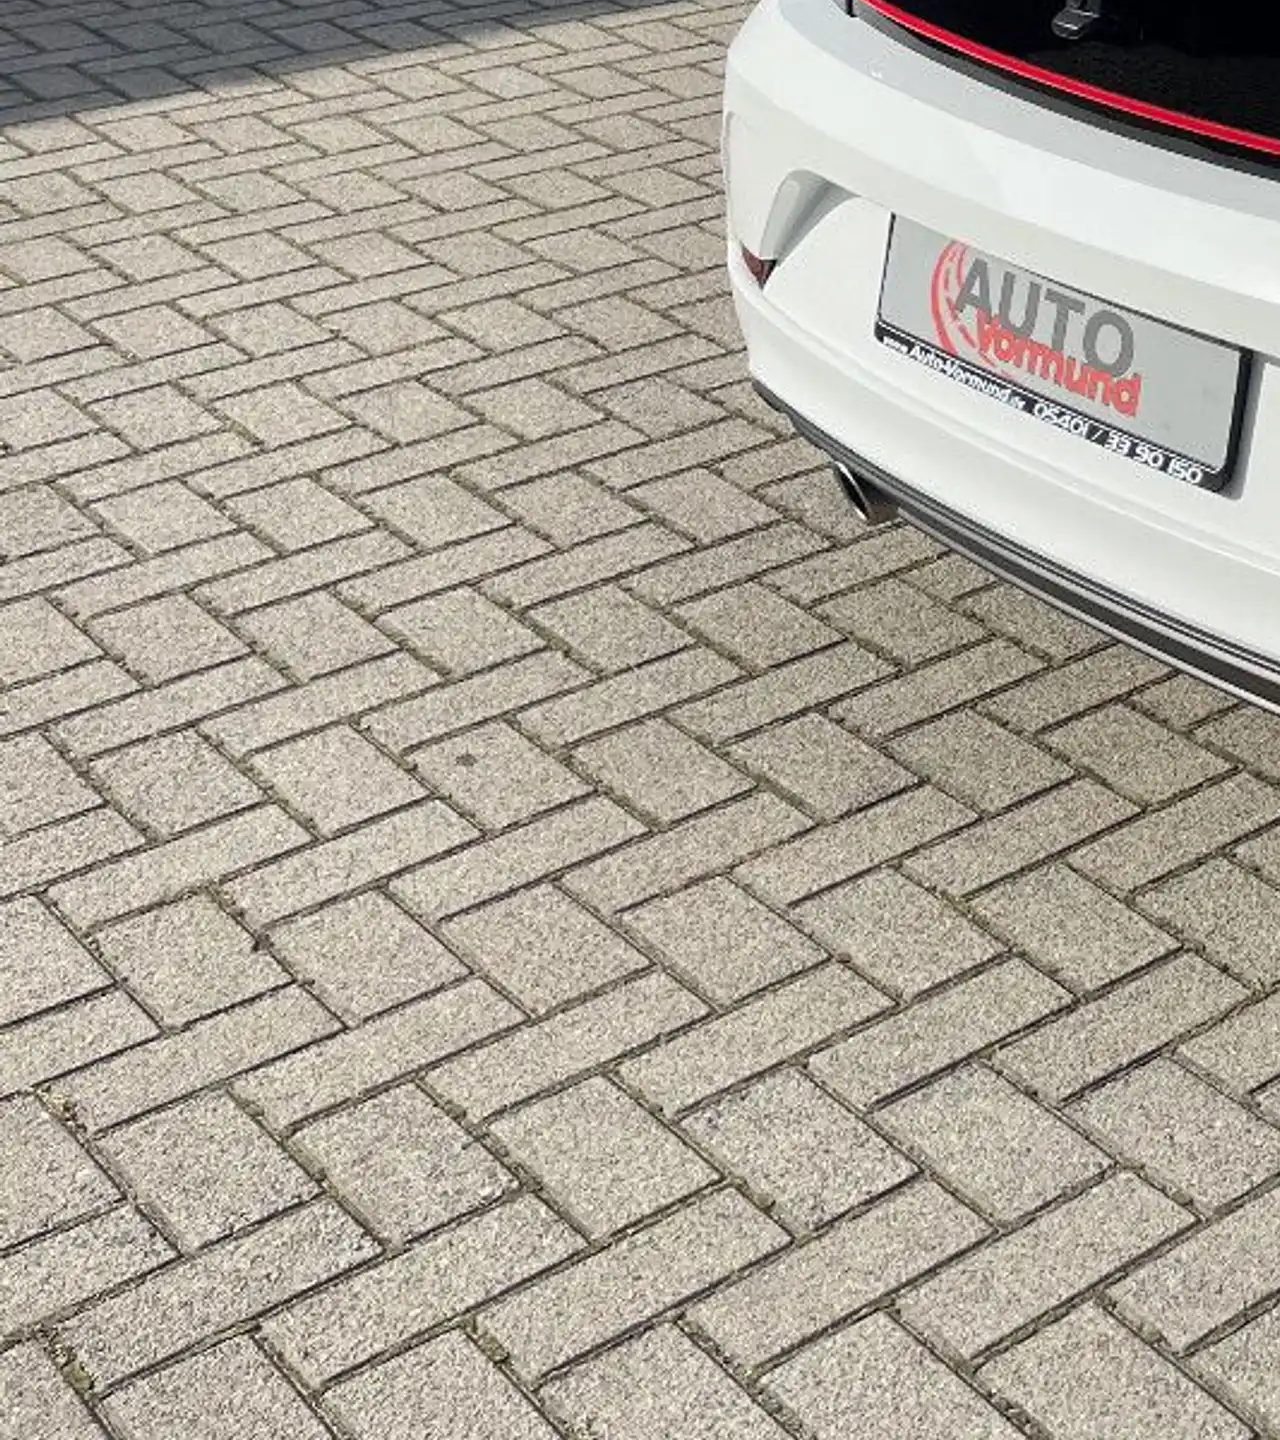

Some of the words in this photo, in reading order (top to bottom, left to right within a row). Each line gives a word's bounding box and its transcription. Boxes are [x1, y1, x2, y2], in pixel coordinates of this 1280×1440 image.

[955, 257, 1134, 378] AUTO
[1034, 402, 1089, 437] 05401
[1104, 429, 1132, 455] 33
[1133, 443, 1164, 468] 90
